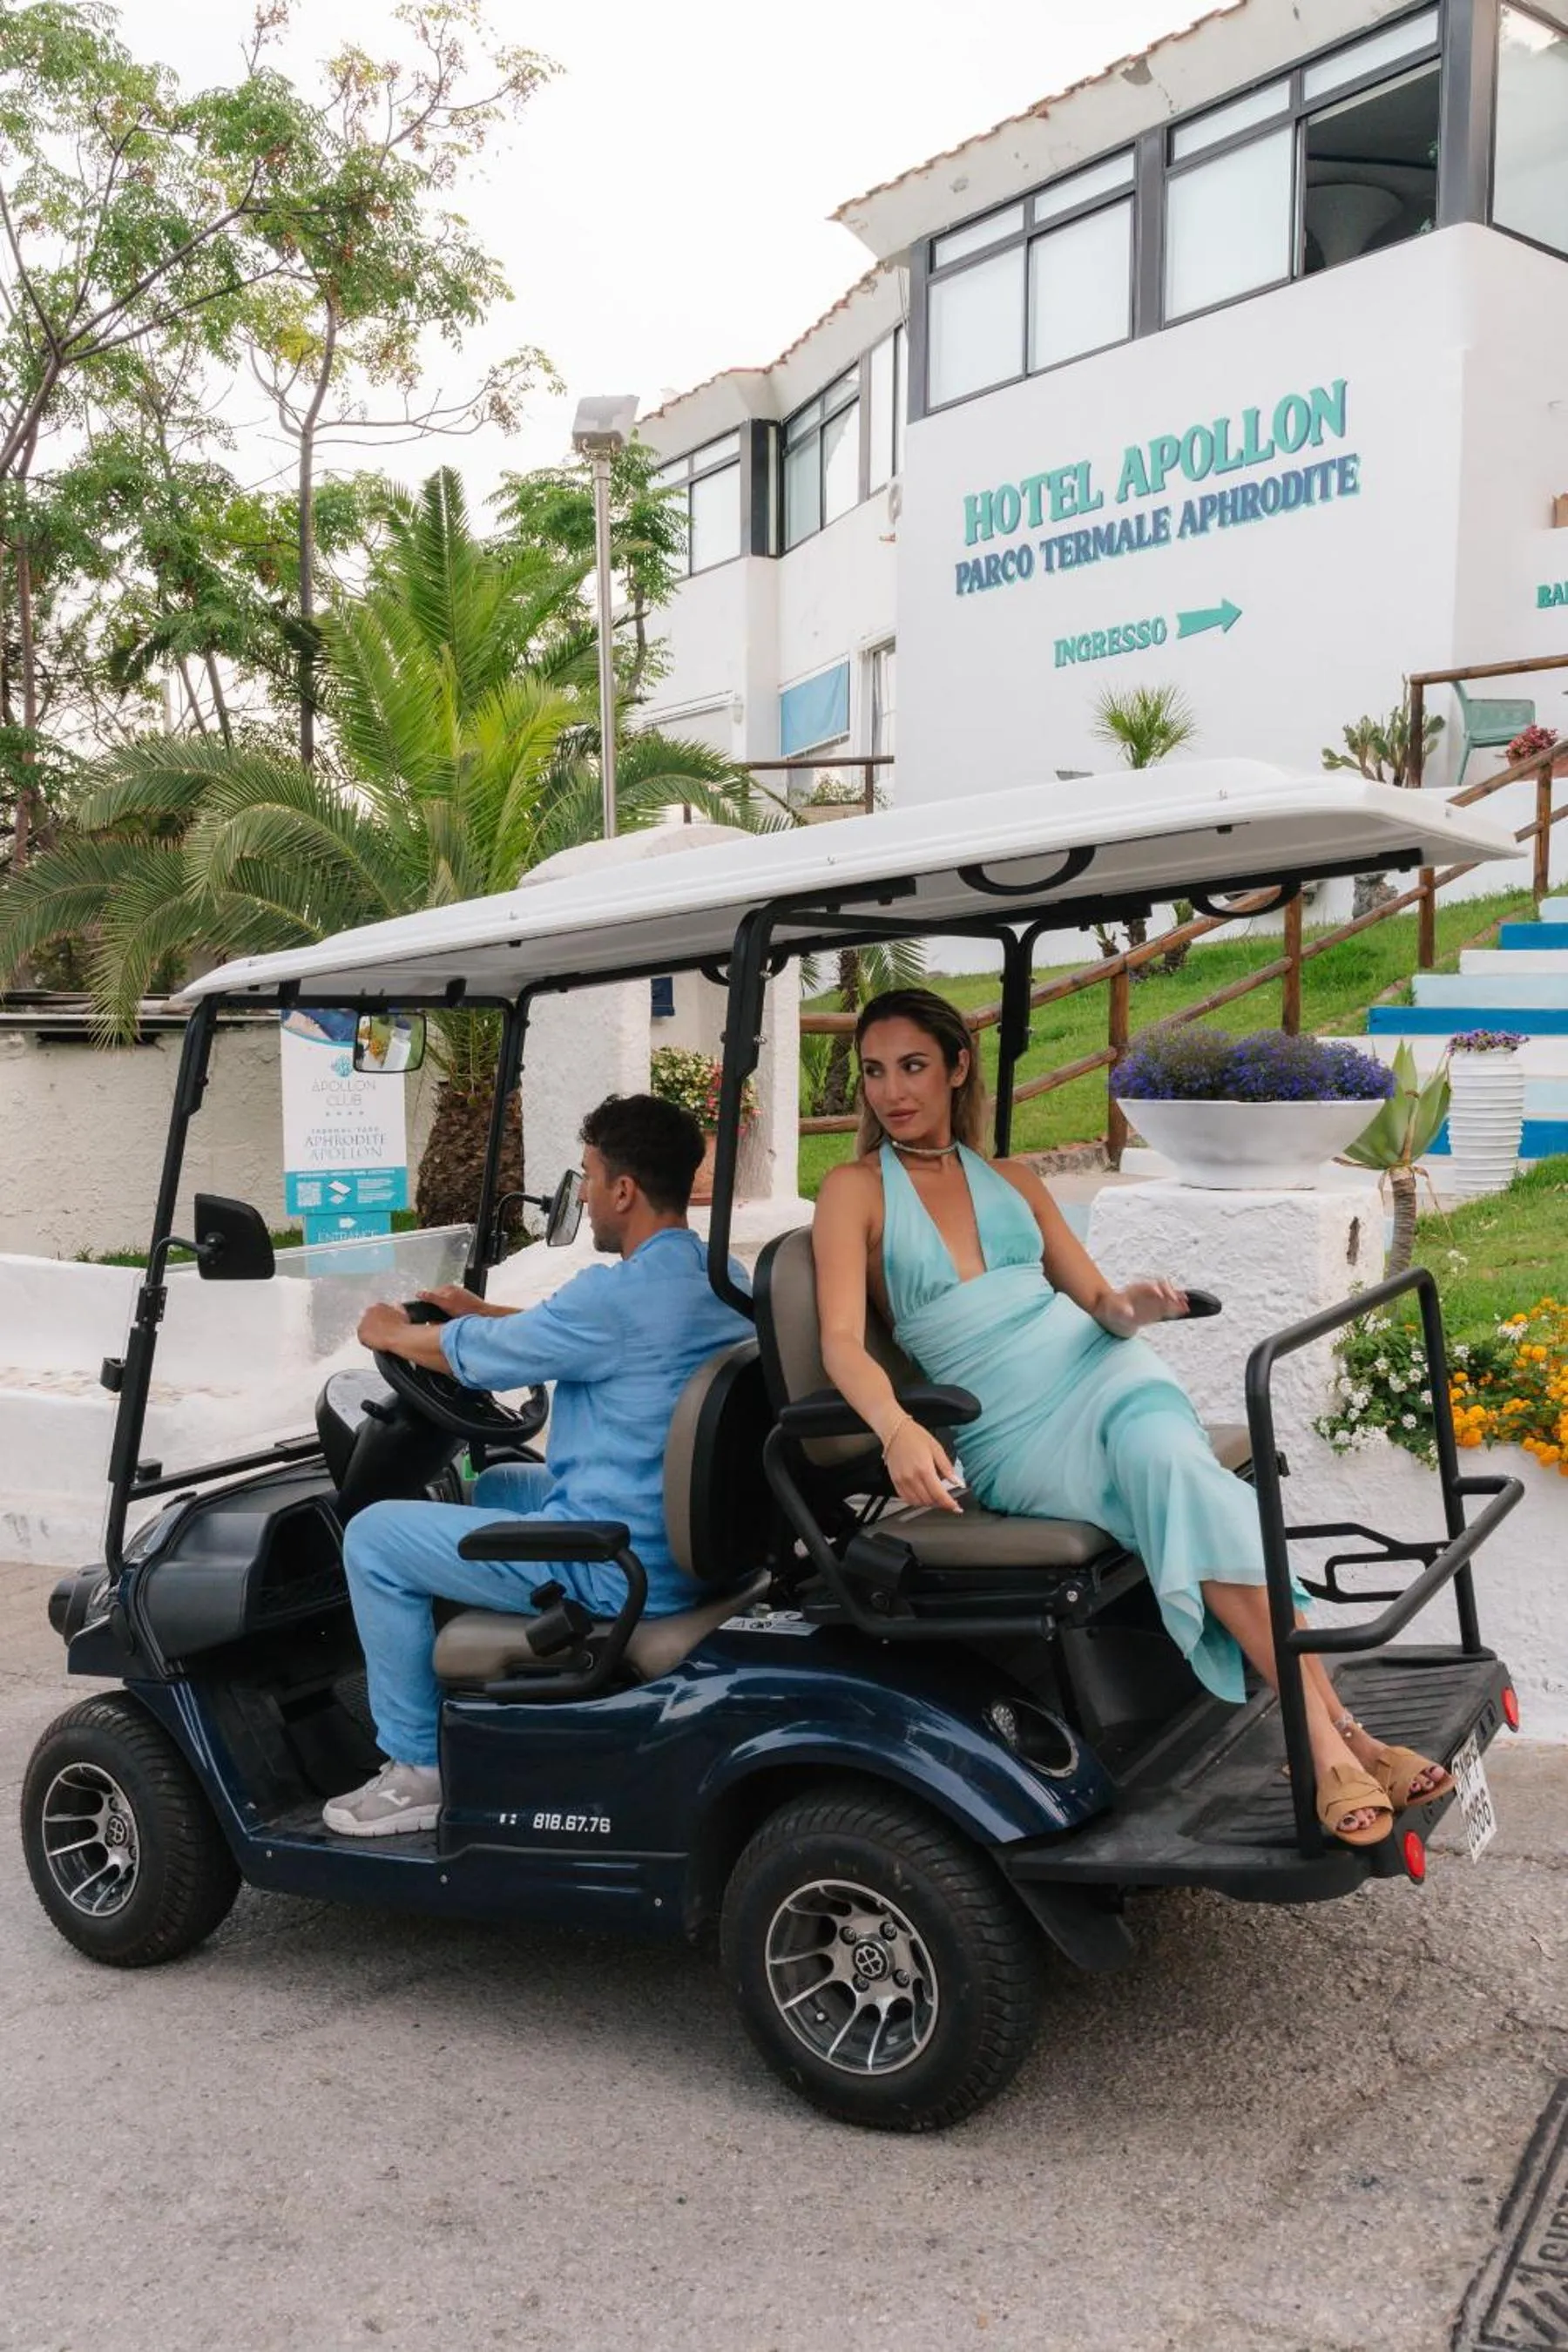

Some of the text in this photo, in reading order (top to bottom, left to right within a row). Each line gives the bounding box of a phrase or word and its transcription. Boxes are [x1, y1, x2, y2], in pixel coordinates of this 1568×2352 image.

[964, 378, 1348, 546] HOTEL APOLLON
[956, 452, 1360, 595] PARCO TERMALE APHRODITE
[1053, 617, 1167, 668] INGRESSO
[532, 1812, 612, 1834] 818.67.76
